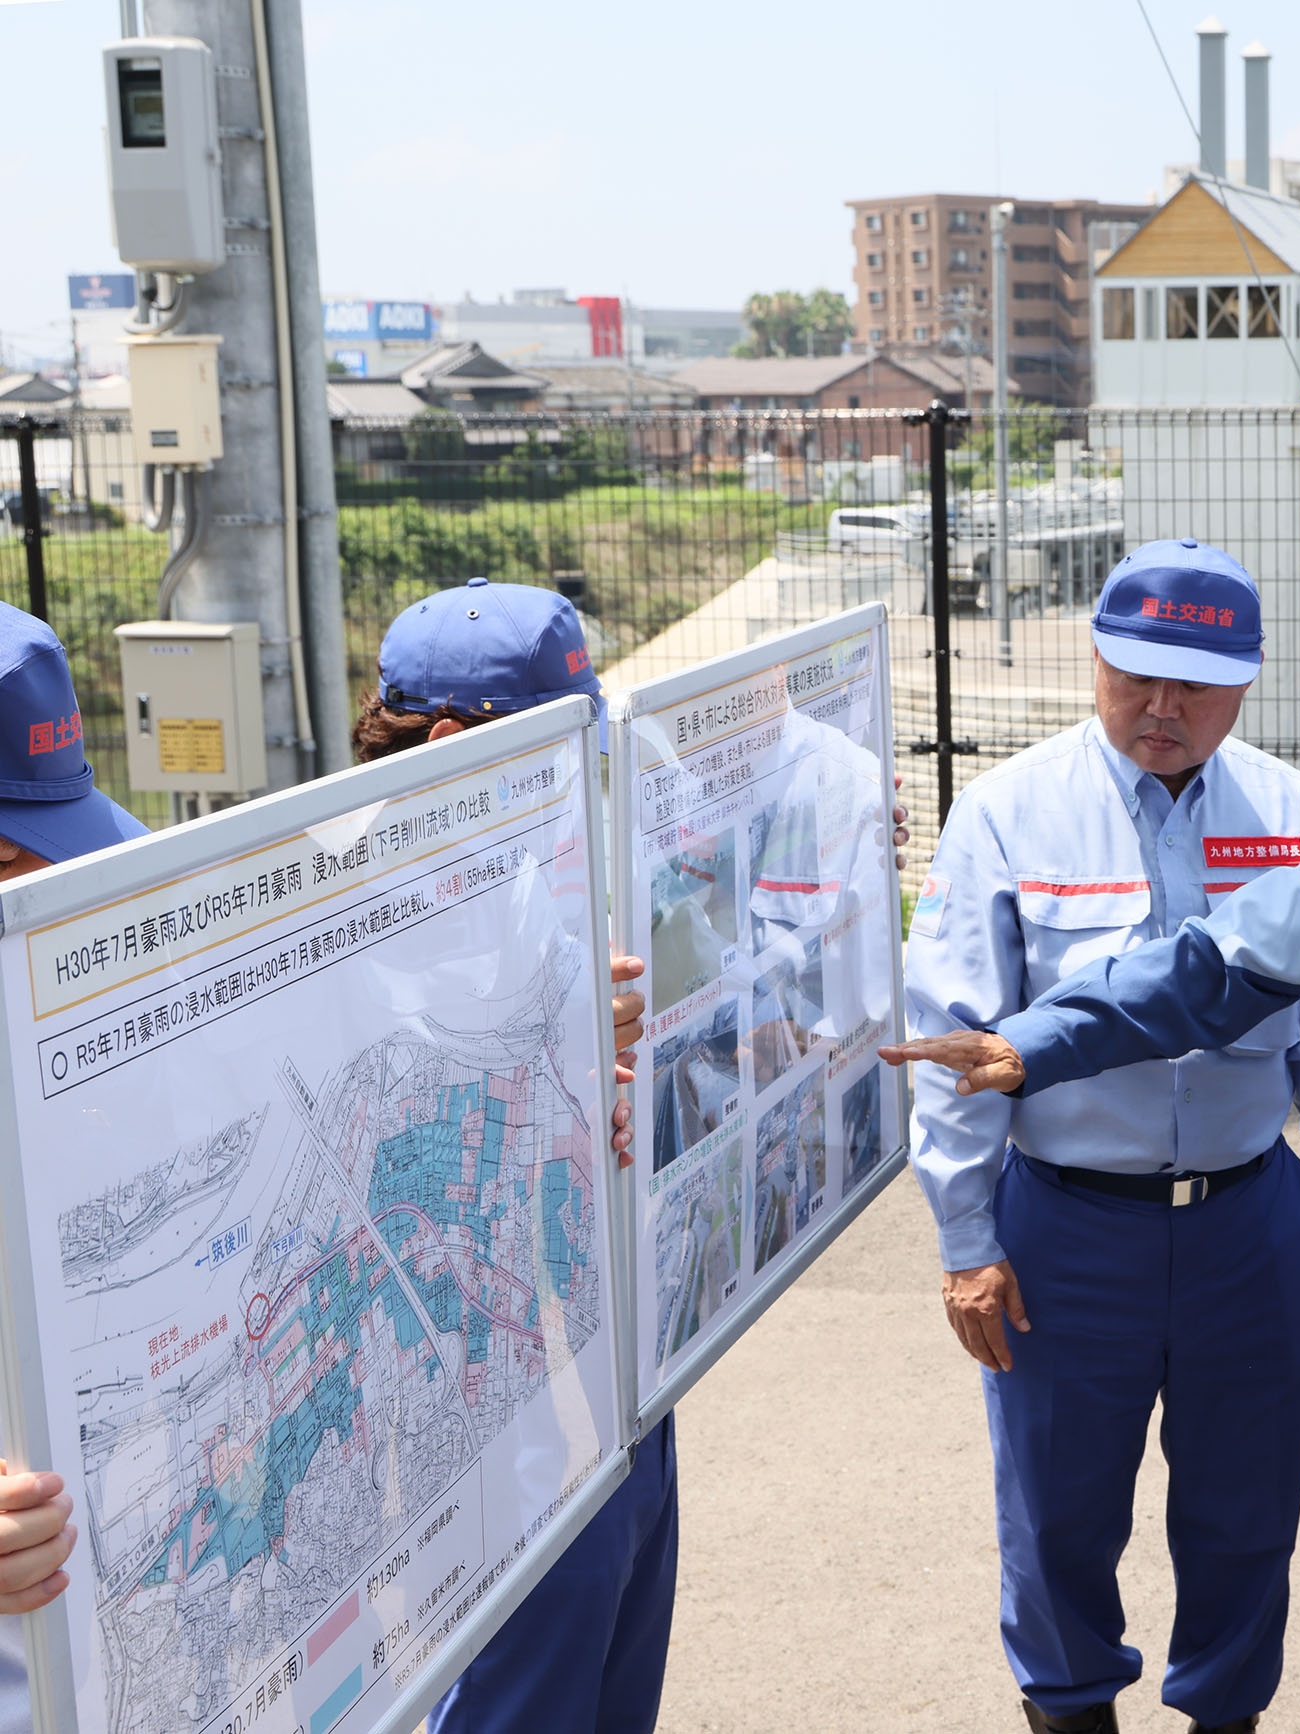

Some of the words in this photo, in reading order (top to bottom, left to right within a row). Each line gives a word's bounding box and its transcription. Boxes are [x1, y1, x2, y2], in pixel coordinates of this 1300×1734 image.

[1142, 598, 1234, 627] 国土交通省
[1210, 845, 1300, 857] 九州地方整備局長
[56, 862, 302, 985] H30年7月豪雨及びR5年7月豪雨
[211, 1223, 248, 1263] 筑後川
[273, 1228, 303, 1258] 下弓削川
[150, 1313, 228, 1380] 枝光上流排水機場
[366, 1549, 411, 1604] 約130ha
[372, 1619, 411, 1670] 約75ha
